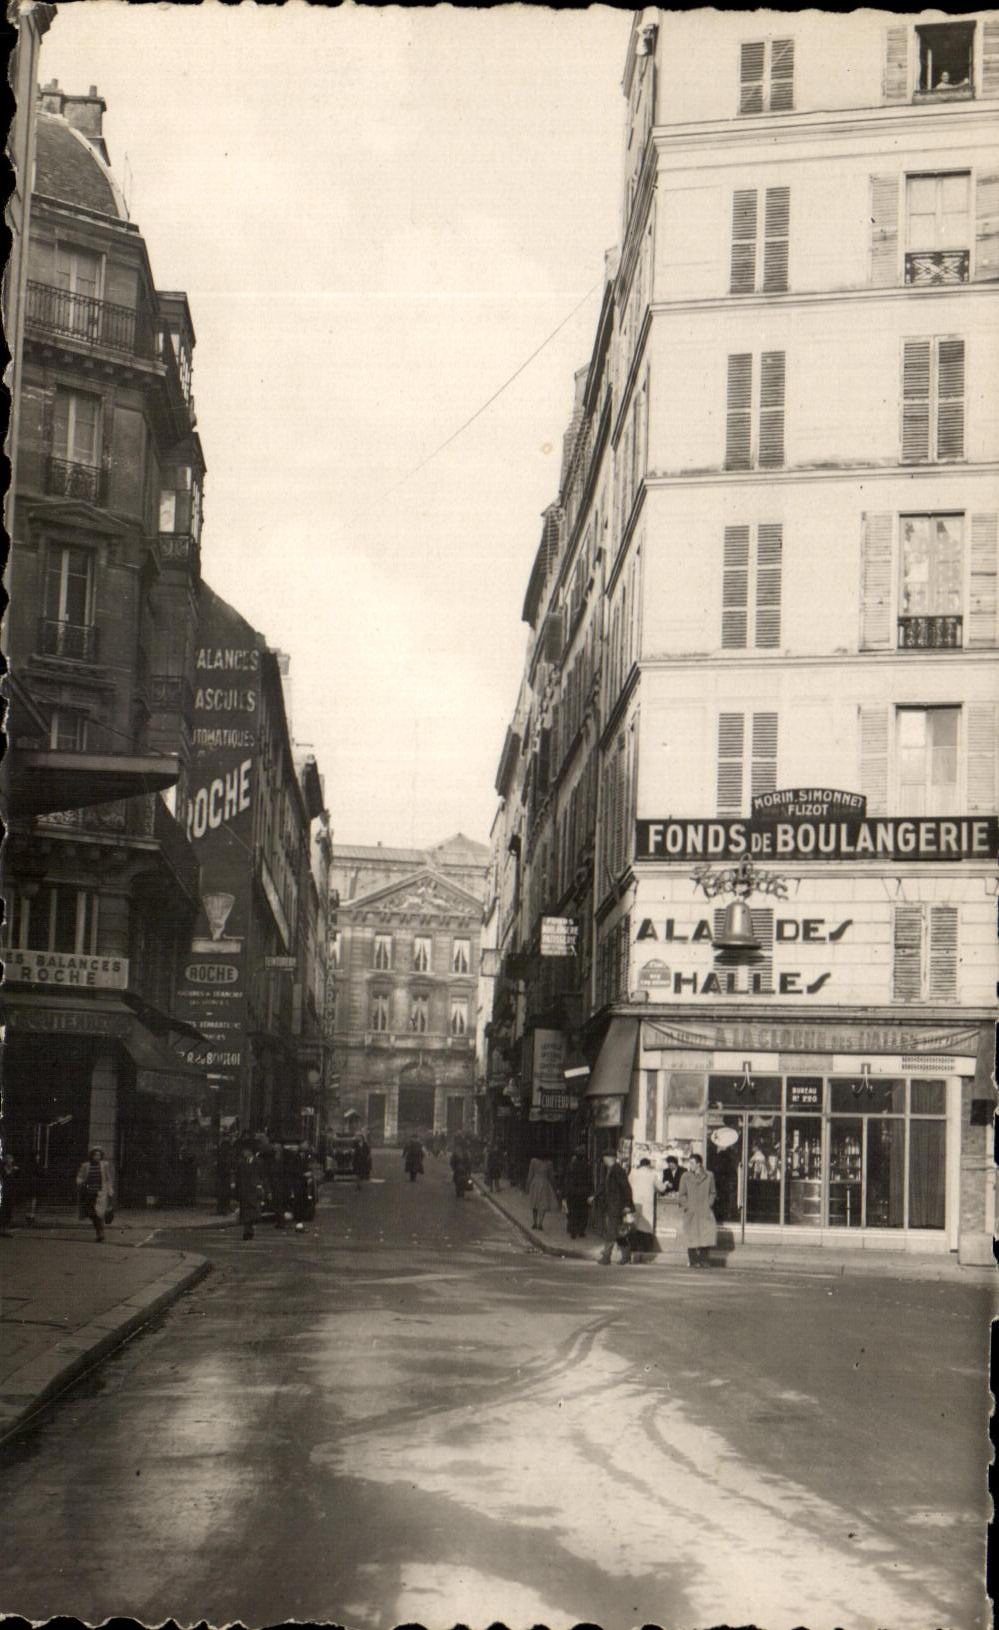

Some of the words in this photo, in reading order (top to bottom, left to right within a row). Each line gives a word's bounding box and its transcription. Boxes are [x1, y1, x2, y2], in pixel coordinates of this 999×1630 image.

[196, 648, 260, 671] ALANCES
[194, 688, 257, 712] ASCULES
[191, 728, 256, 748] UTOMATIQUES
[186, 759, 253, 843] OCHE
[798, 789, 864, 809] SIMONNET
[787, 803, 829, 817] FLIZOT
[647, 823, 747, 854] FONDS
[751, 832, 772, 854] DE
[775, 821, 990, 853] BOULANGERIE
[636, 918, 660, 942] A
[665, 918, 715, 942] LA
[775, 918, 855, 942] DES
[6, 952, 24, 965] ES
[36, 955, 121, 972] BALANCES
[21, 966, 97, 985] ROCHE
[190, 966, 234, 982] ROCHE
[673, 972, 832, 995] HALLES
[791, 1086, 817, 1094] BUREAU
